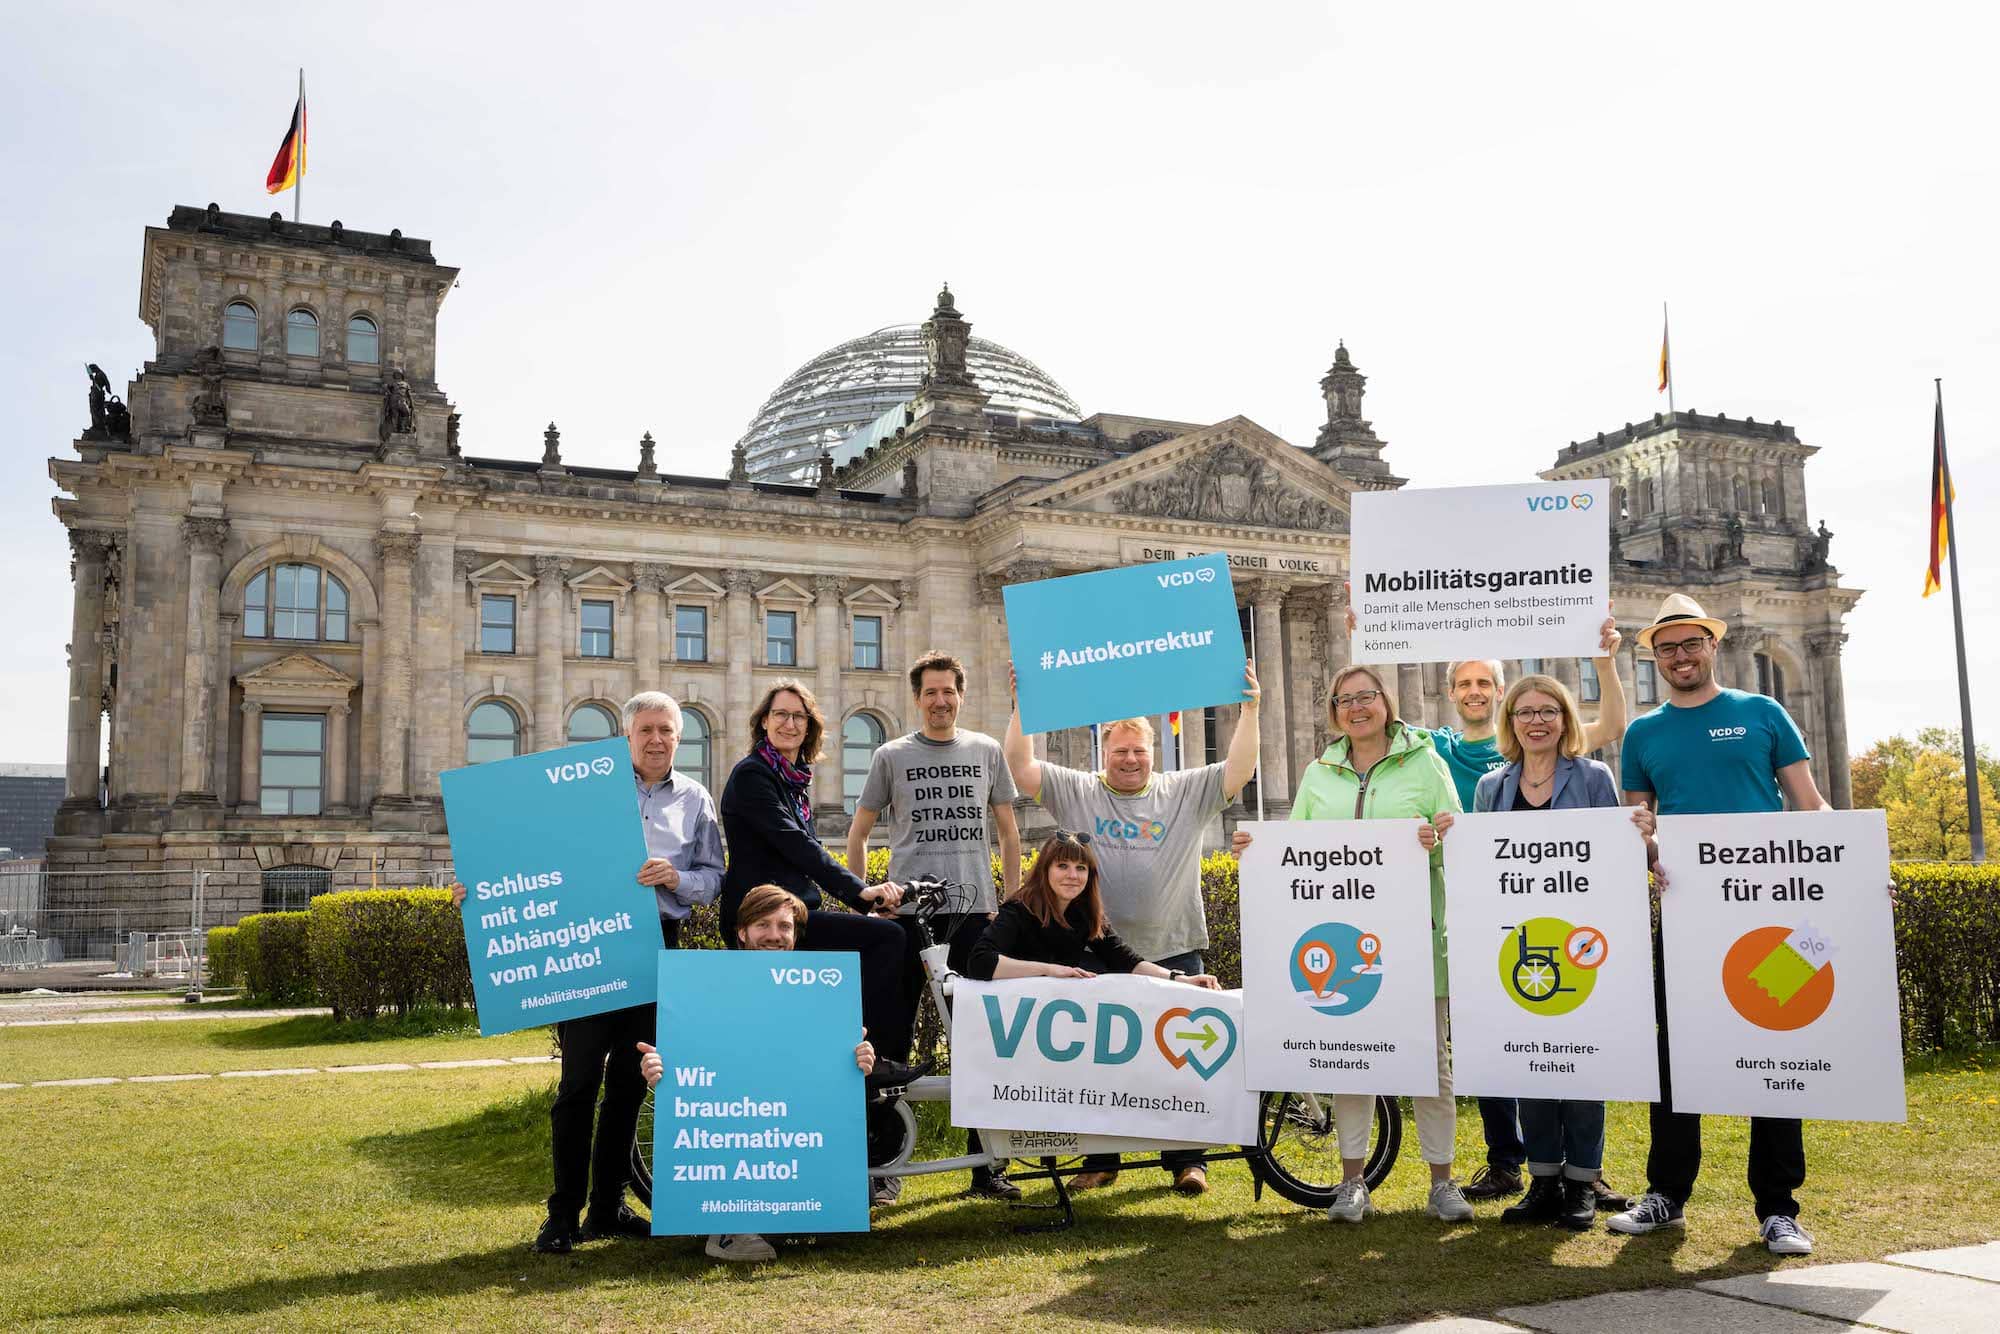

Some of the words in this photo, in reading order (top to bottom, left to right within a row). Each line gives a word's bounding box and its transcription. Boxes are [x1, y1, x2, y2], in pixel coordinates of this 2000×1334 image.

[1526, 496, 1568, 511] VCD
[1143, 548, 1175, 561] DEM
[1279, 558, 1319, 572] VOLKE
[1157, 571, 1195, 588] VCD
[1365, 563, 1593, 593] Mobilitätsgarantie
[1364, 601, 1399, 614] Damit
[1402, 600, 1423, 613] alle
[1427, 598, 1490, 612] Menschen
[1494, 595, 1593, 609] selbstbestimmt
[1364, 620, 1387, 633] und
[1391, 616, 1492, 632] klimaverträglich
[1497, 615, 1533, 627] mobil
[1537, 614, 1565, 626] sein
[1040, 628, 1214, 671] #Autokorrektur
[1364, 639, 1412, 651] können.
[1709, 728, 1732, 737] VCD
[546, 762, 590, 784] VCD
[906, 765, 982, 781] EROBERE
[915, 787, 943, 800] DIR
[948, 785, 974, 798] DIE
[911, 806, 982, 822] STRASSE
[915, 825, 983, 843] ZURÜCK!
[1281, 845, 1383, 871] Angebot
[1495, 838, 1591, 864] Zugang
[1699, 840, 1845, 865] Bezahlbar
[476, 870, 563, 900] Schluss
[1290, 879, 1324, 900] für
[1332, 879, 1375, 900] alle
[1499, 872, 1535, 894] für
[1543, 871, 1589, 893] alle
[1722, 878, 1762, 901] für
[1772, 878, 1824, 901] alle
[481, 907, 517, 929] mit
[522, 899, 559, 921] der
[486, 912, 632, 958] Abhängigkeit
[1364, 941, 1373, 950] H
[1799, 937, 1825, 955] %
[490, 963, 538, 986] vom
[544, 946, 601, 976] Auto!
[1311, 953, 1324, 968] H
[771, 968, 816, 985] VCD
[521, 978, 628, 1010] #Mobilitätsgarantie
[982, 995, 1143, 1065] VCD
[1283, 1039, 1316, 1051] durch
[1320, 1040, 1396, 1052] bundesweite
[1504, 1041, 1539, 1053] durch
[1543, 1042, 1600, 1054] Barriere-
[1309, 1058, 1370, 1070] Standards
[1529, 1060, 1575, 1073] freiheit
[1736, 1057, 1775, 1070] durch
[1780, 1059, 1831, 1071] soziale
[675, 1067, 716, 1087] Wir
[1763, 1078, 1805, 1091] Tarife
[674, 1097, 787, 1118] brauchen
[993, 1085, 1074, 1104] Mobilität
[1079, 1089, 1106, 1106] für
[1112, 1092, 1210, 1114] Menschen.
[674, 1128, 823, 1149] Alternativen
[673, 1164, 726, 1181] zum
[733, 1159, 798, 1181] Auto!
[701, 1198, 822, 1214] #Mobilitätsgarantie
